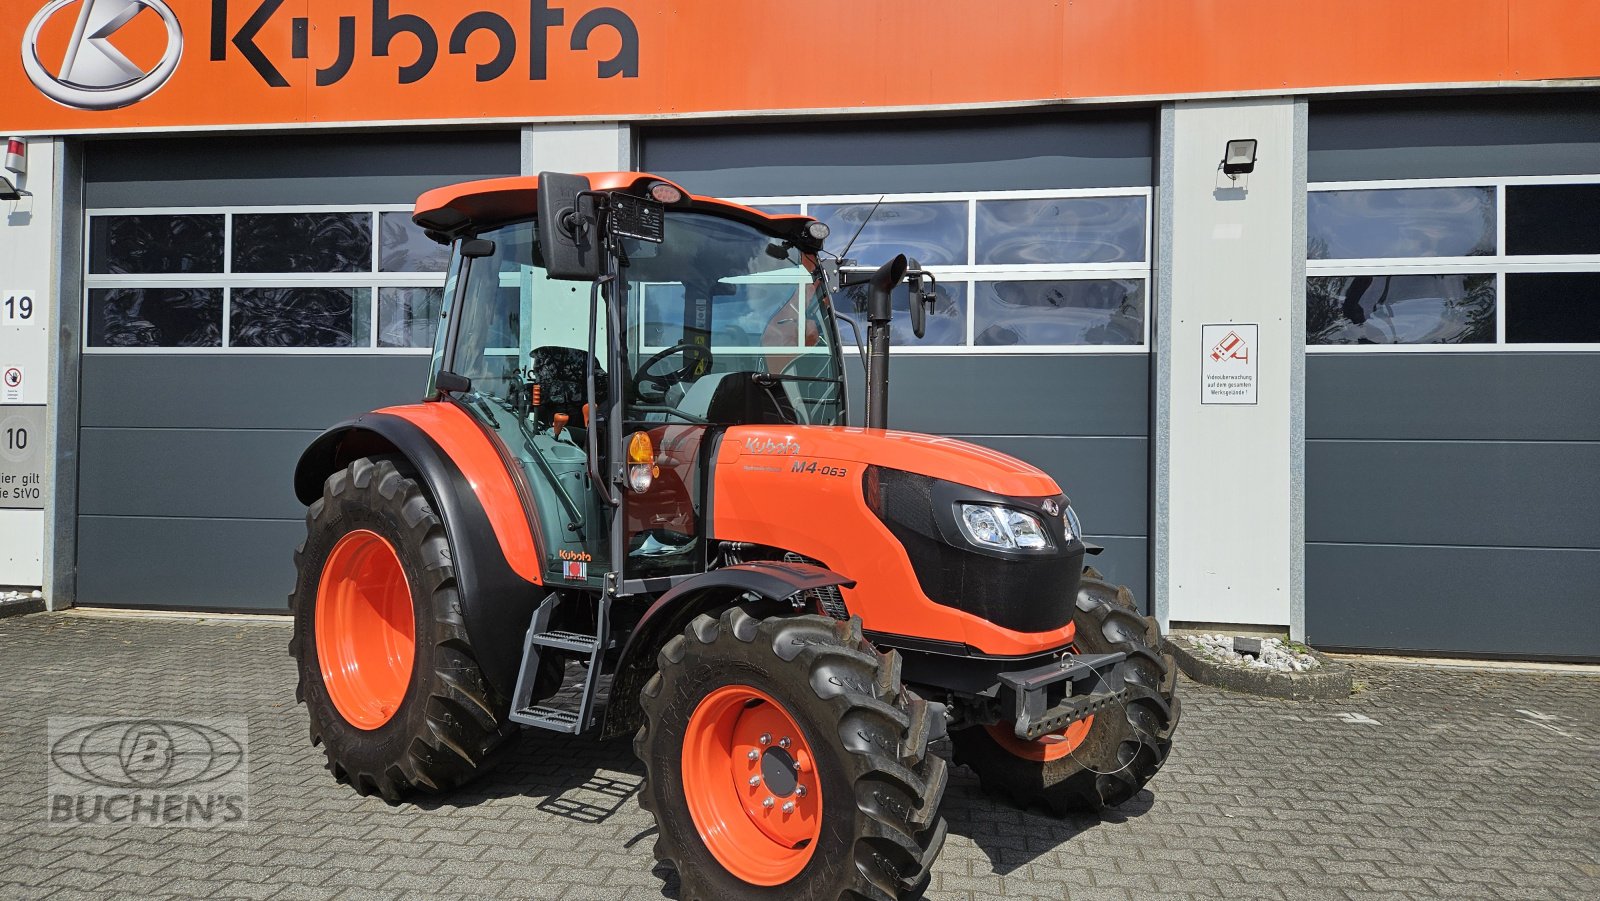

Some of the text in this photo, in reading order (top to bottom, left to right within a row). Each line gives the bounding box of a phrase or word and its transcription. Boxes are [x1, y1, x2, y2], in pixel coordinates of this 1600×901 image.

[209, 0, 639, 88] Kubota
[5, 296, 33, 319] 19
[6, 427, 28, 450] 10
[745, 437, 801, 455] Kubota
[790, 461, 847, 478] M4-063
[22, 472, 40, 487] gilt
[13, 487, 40, 499] StVO
[559, 550, 592, 561] Kubota
